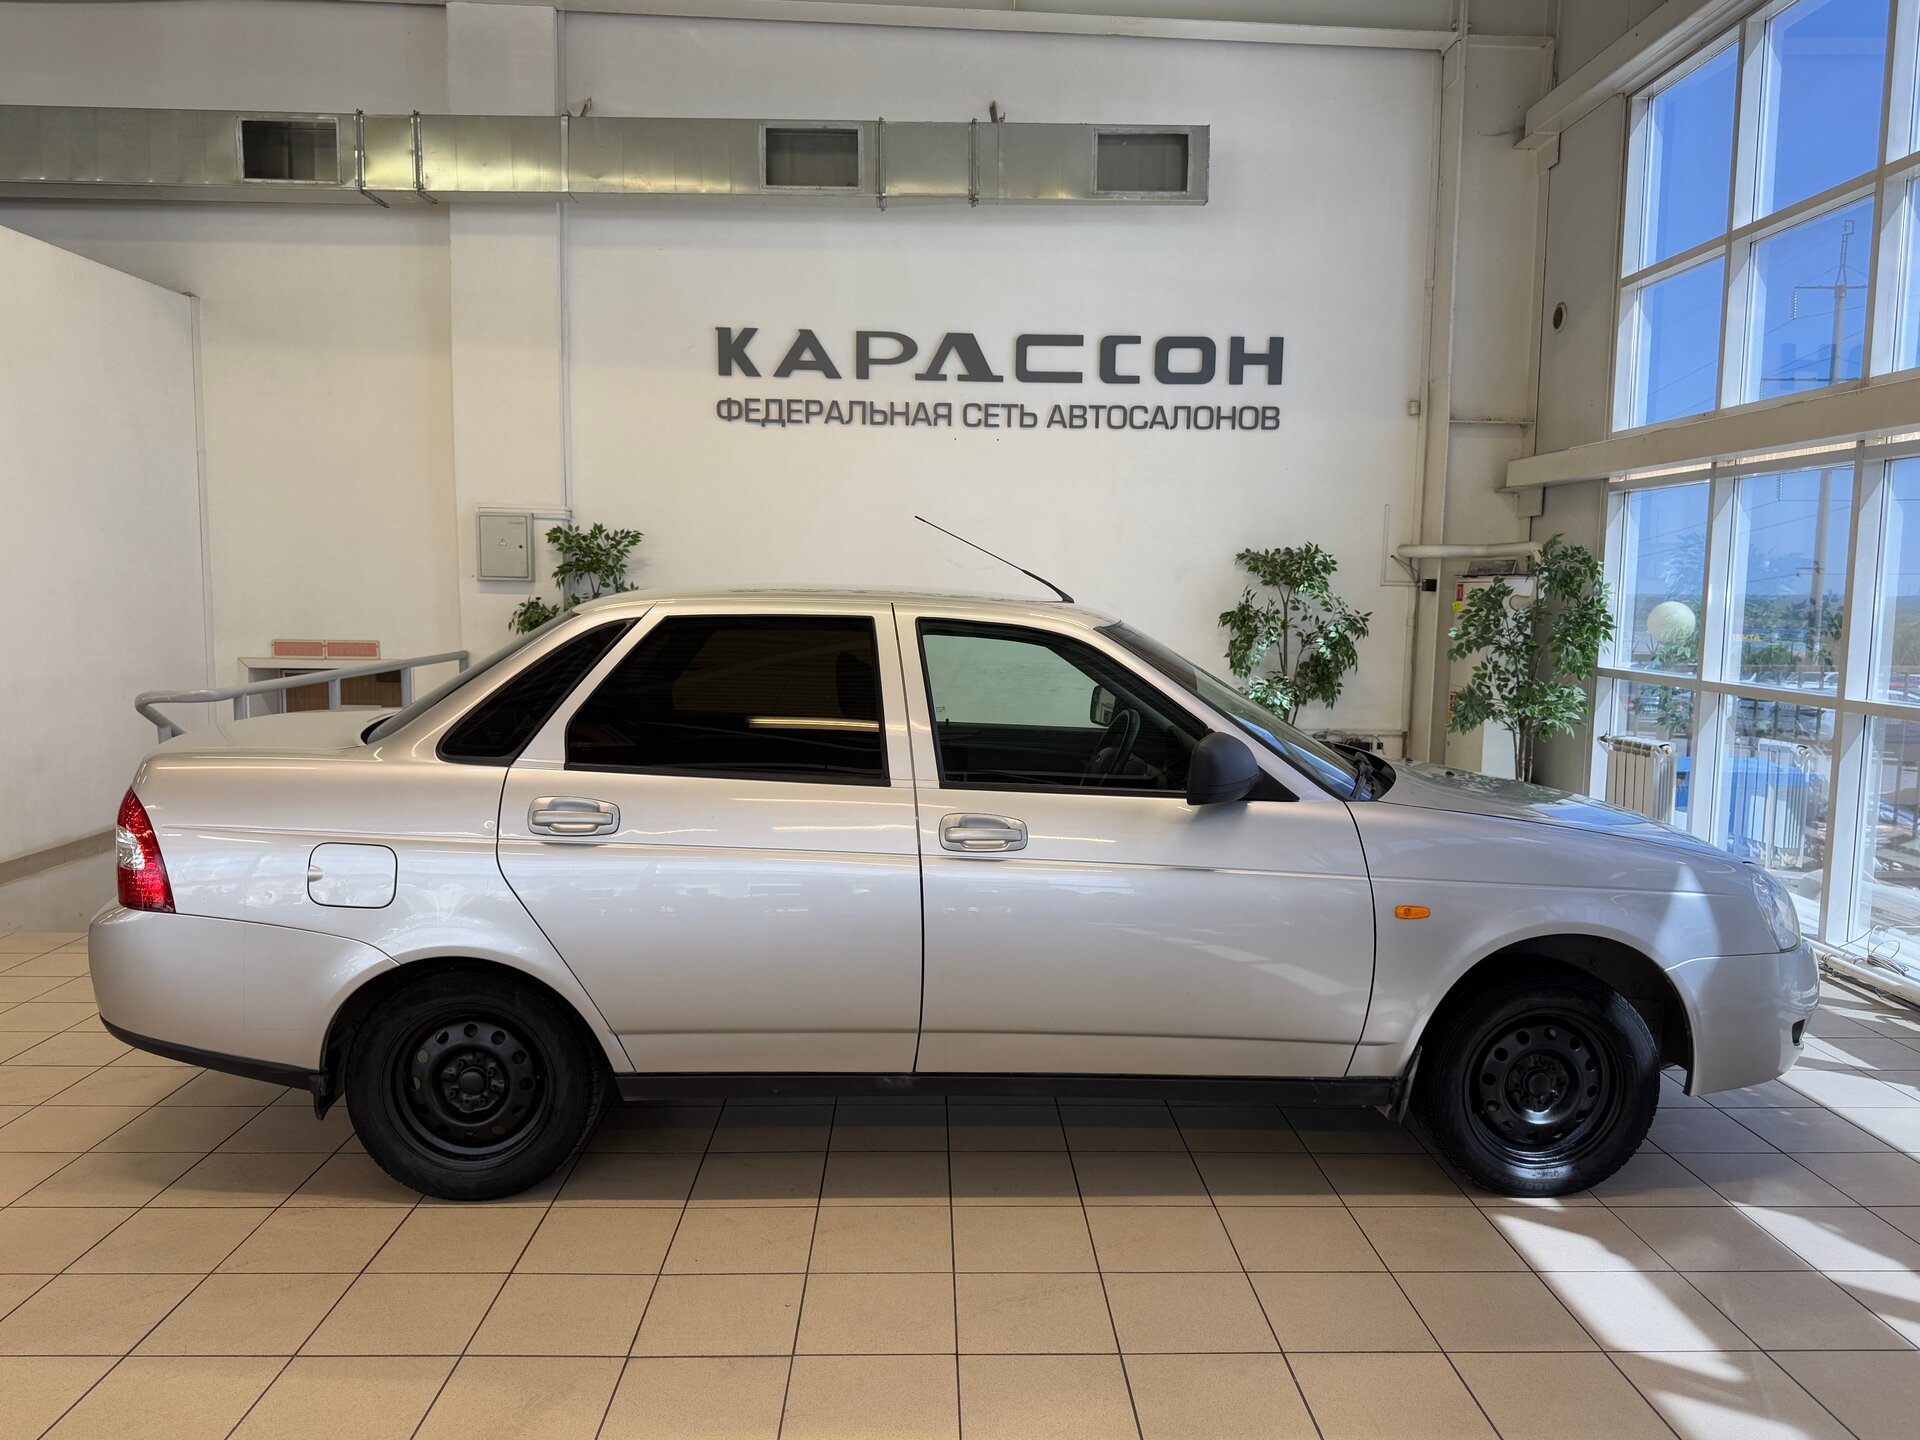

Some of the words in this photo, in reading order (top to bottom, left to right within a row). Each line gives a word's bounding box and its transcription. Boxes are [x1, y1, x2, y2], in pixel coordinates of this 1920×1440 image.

[715, 327, 1284, 385] КАРЛССОН
[716, 398, 952, 427] ФЕДЕРАЛЬНАЯ
[963, 403, 1037, 428] СЕТЬ
[1047, 405, 1280, 430] АВТОСАЛОНОВ
